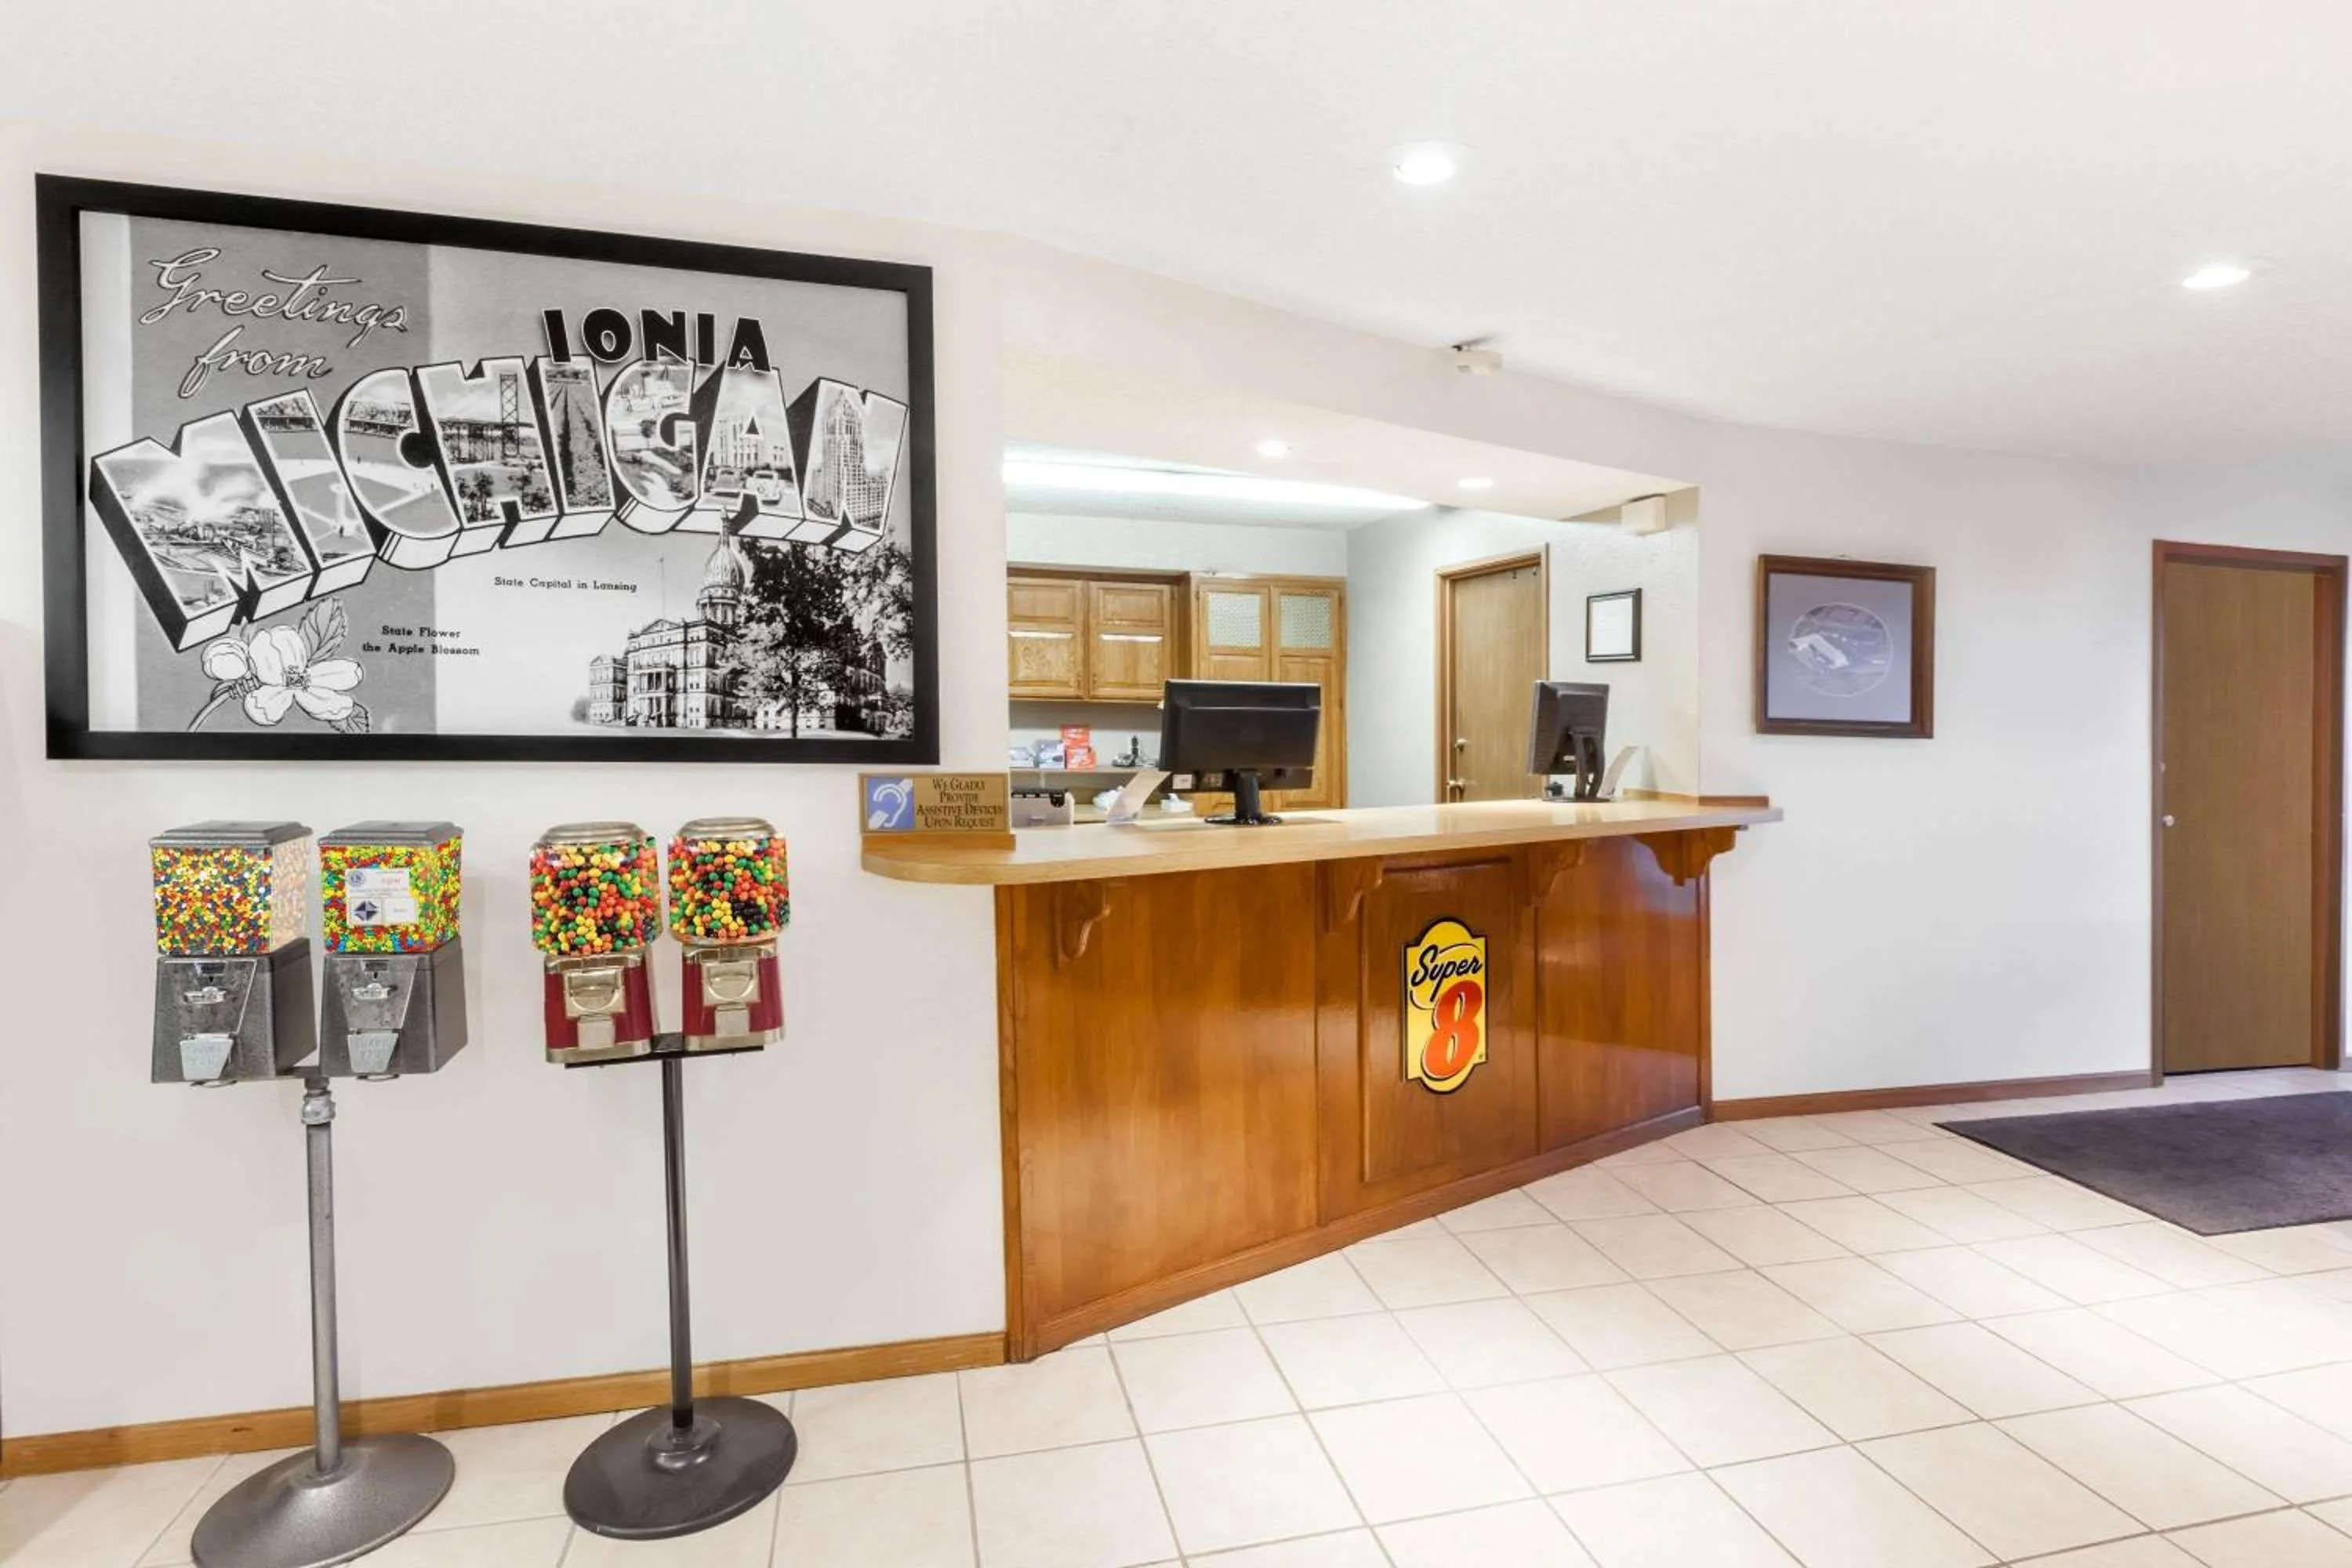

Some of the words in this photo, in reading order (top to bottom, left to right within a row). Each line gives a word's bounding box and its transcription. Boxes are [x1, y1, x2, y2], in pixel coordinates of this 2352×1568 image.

[139, 247, 408, 347] Greetings
[179, 325, 333, 398] from
[543, 307, 772, 372] IONIA
[89, 357, 909, 652] MICHIGAN
[494, 576, 524, 586] State
[577, 580, 587, 589] in
[593, 580, 637, 593] Lansing
[362, 641, 381, 652] the
[387, 643, 424, 655] Apple
[431, 644, 480, 655] Blossom
[382, 625, 413, 637] State
[419, 626, 461, 637] Flower
[1411, 944, 1483, 1002] Super
[1421, 979, 1483, 1081] 8
